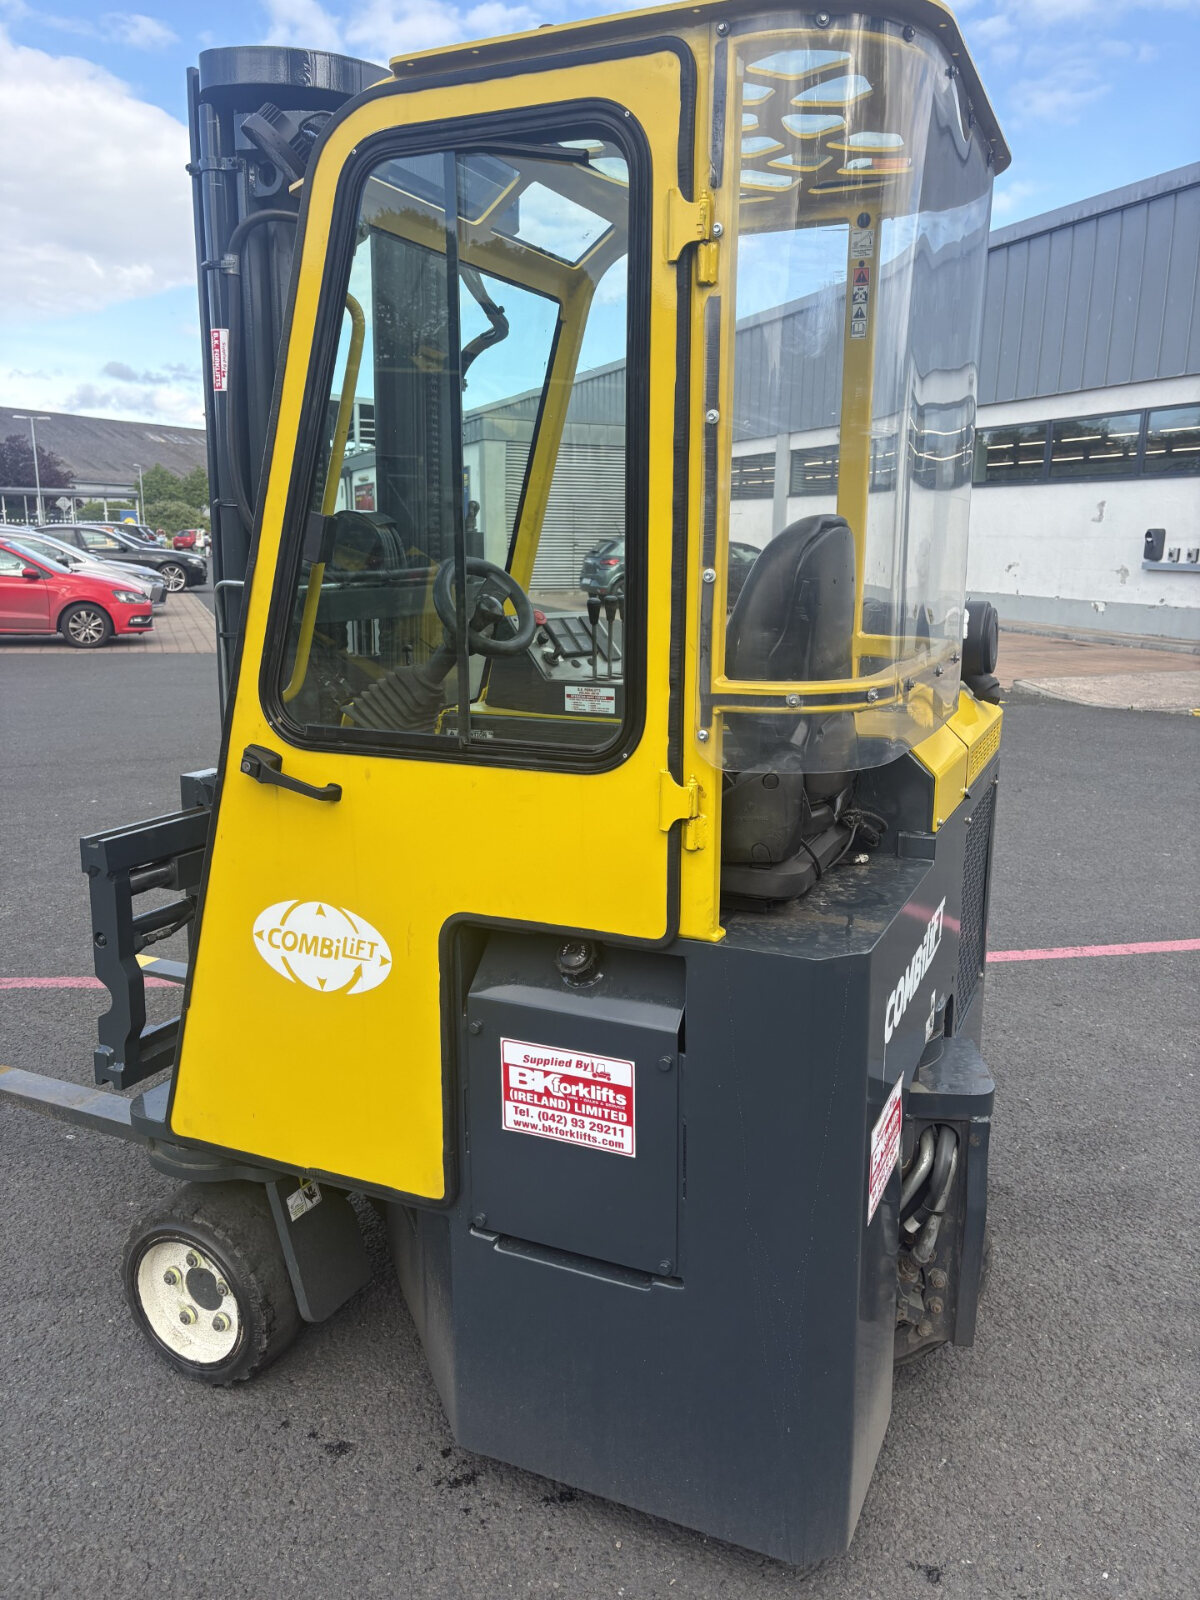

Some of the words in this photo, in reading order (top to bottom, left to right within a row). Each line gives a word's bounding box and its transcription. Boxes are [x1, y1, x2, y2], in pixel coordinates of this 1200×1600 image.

[213, 349, 221, 387] FORKLIFTS
[523, 1054, 572, 1068] Supplied
[575, 1059, 591, 1072] By
[509, 1088, 571, 1112] (IRELAND)
[574, 1102, 628, 1123] LIMITED
[513, 1105, 534, 1119] Tel.
[538, 1110, 567, 1127] (042)
[571, 1117, 585, 1129] 93
[589, 1121, 625, 1138] 29211
[513, 1119, 625, 1149] www.bkforklifts.com
